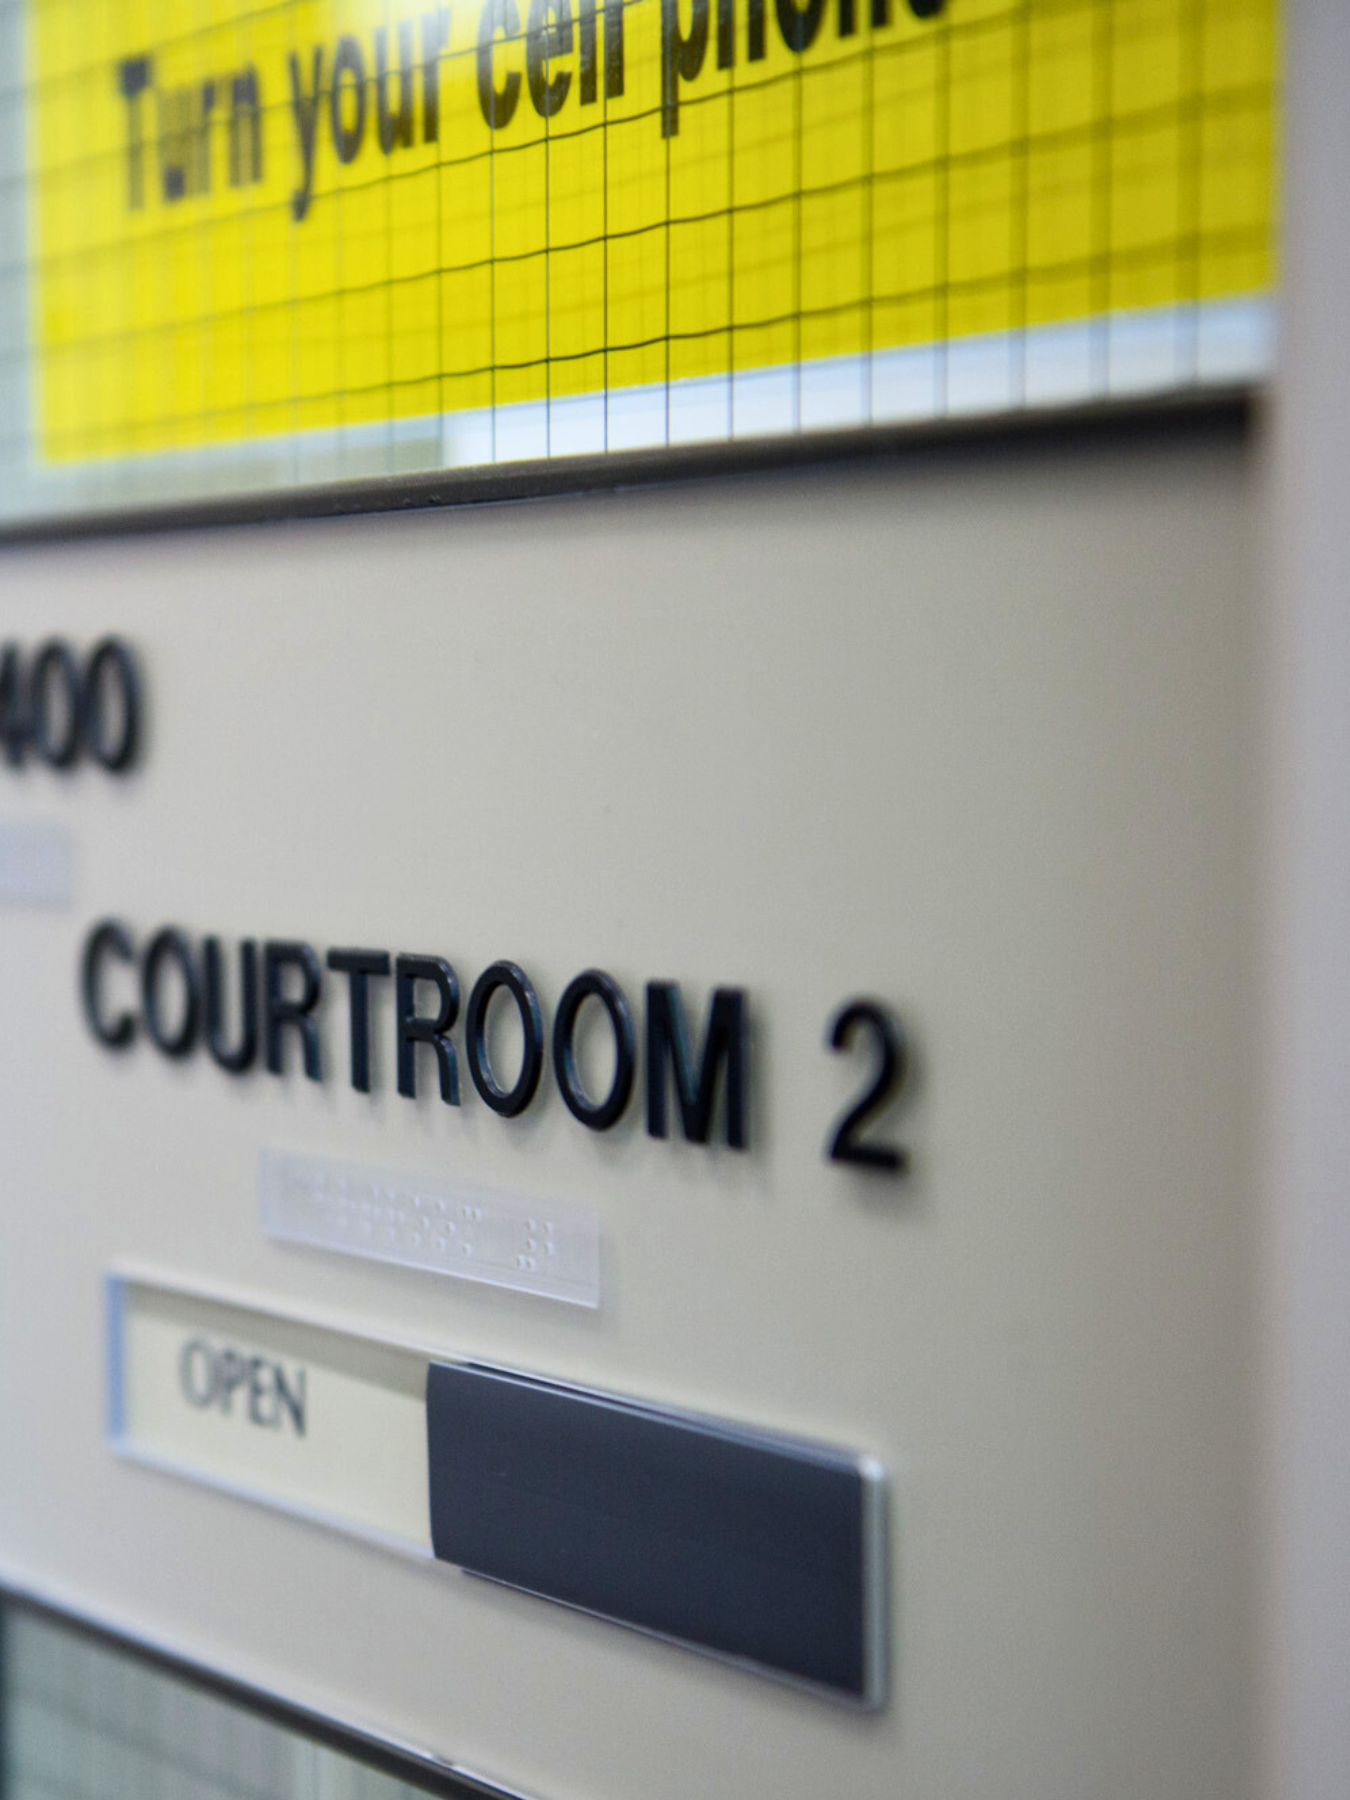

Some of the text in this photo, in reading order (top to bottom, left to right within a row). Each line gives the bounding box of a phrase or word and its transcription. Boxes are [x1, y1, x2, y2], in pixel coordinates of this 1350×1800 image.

[119, 55, 262, 206] Turn
[288, 9, 451, 223] your
[79, 917, 908, 1173] COURTROOM 2
[178, 1337, 308, 1437] OPEN
